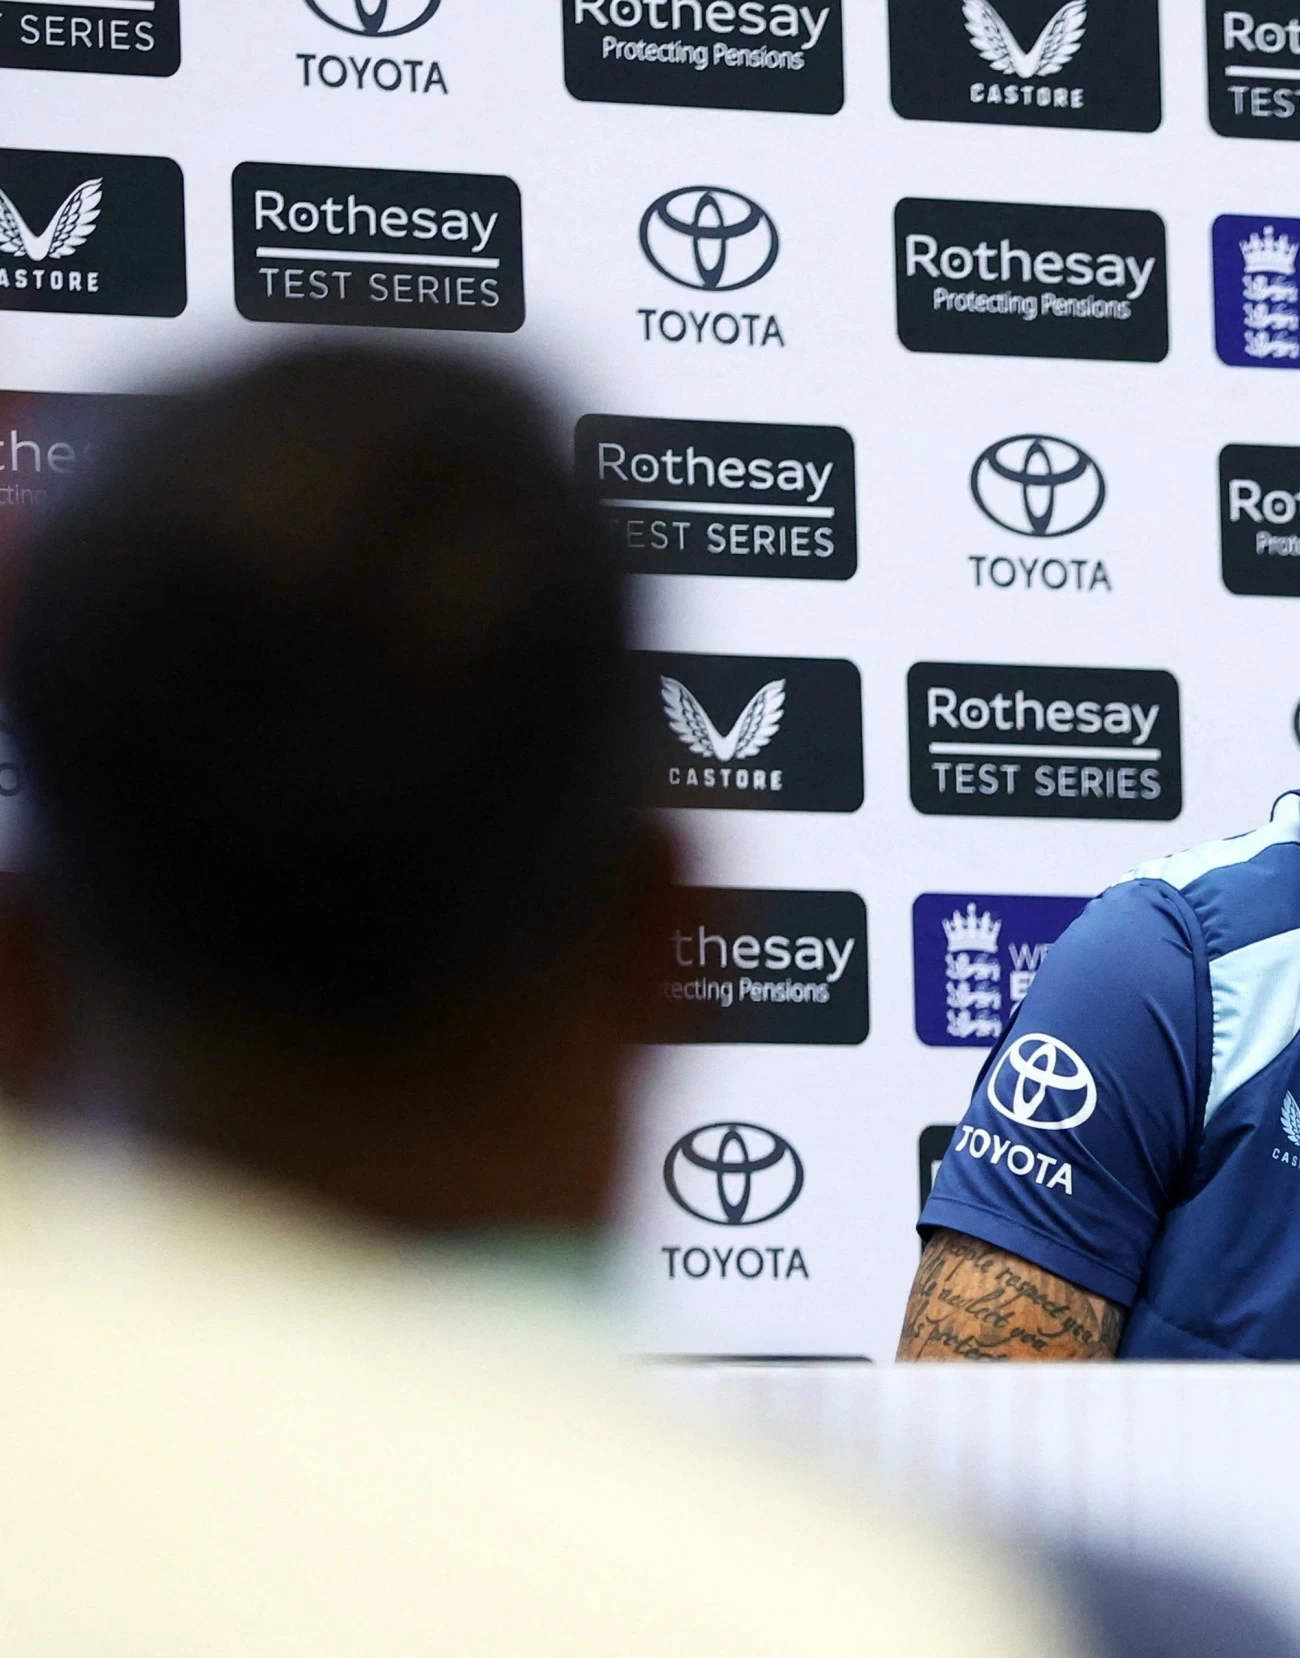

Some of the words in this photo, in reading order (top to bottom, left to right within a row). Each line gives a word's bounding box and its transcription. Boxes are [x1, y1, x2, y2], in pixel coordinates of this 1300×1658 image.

[20, 14, 155, 51] SERIES
[574, 0, 830, 50] Rothesay
[602, 35, 709, 71] Protecting
[713, 42, 805, 71] Pensions
[295, 52, 449, 94] TOYOTA
[969, 82, 1084, 109] CASTORE
[254, 189, 499, 253] Rothesay
[905, 233, 1156, 300] Rothesay
[258, 267, 352, 300] TEST
[369, 273, 500, 307] SERIES
[933, 286, 1039, 321] Protecting
[1040, 292, 1132, 320] Pensions
[637, 308, 785, 348] TOYOTA
[598, 443, 834, 502] Rothesay
[608, 519, 691, 550] EST
[707, 523, 834, 557] SERIES
[968, 554, 1113, 592] TOYOTA
[927, 686, 1160, 746] Rothesay
[668, 767, 784, 791] CASTORE
[931, 762, 1021, 795] TEST
[1034, 765, 1162, 800] SERIES
[739, 977, 830, 1004] Pensions
[955, 1125, 1073, 1195] TOYOTA
[661, 1245, 809, 1280] TOYOTA
